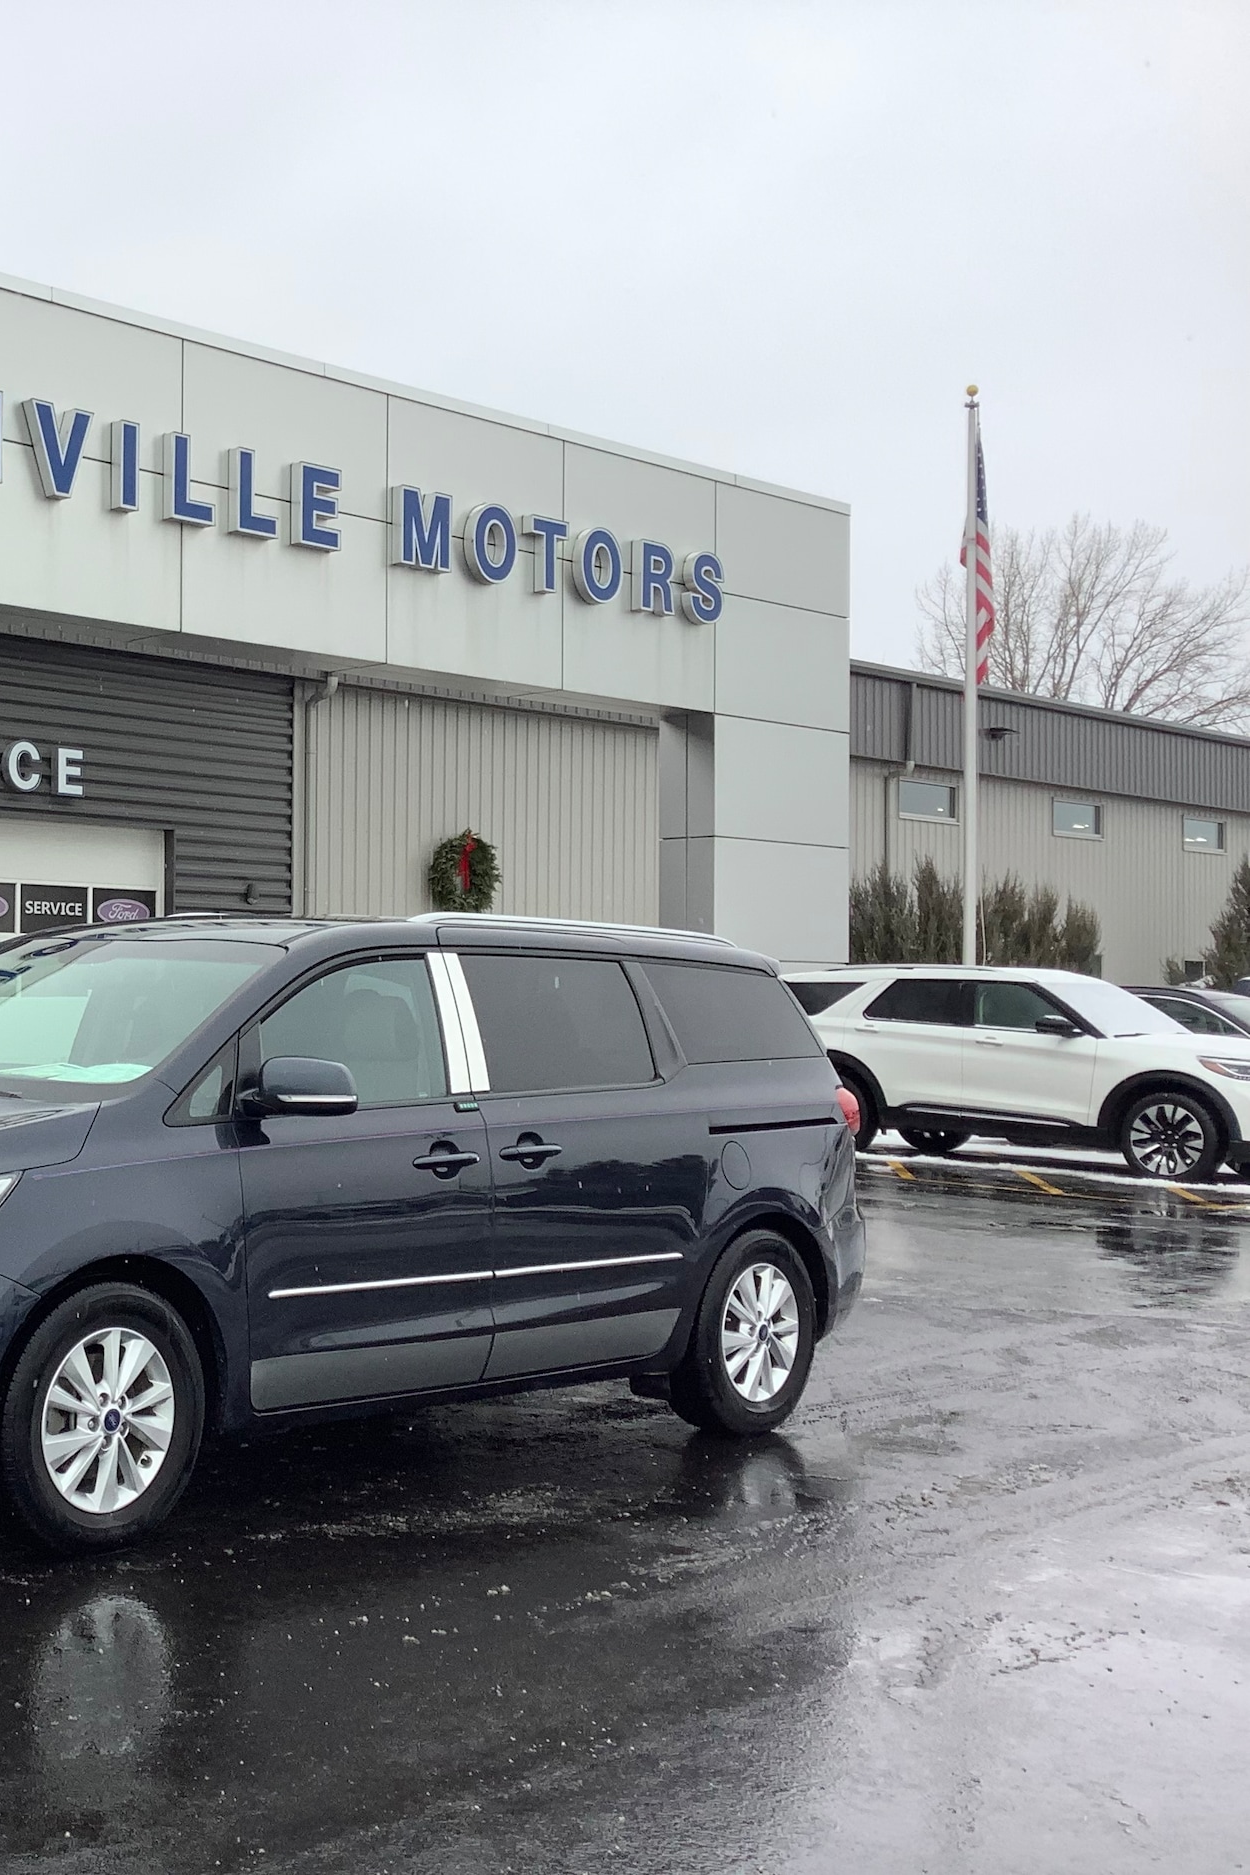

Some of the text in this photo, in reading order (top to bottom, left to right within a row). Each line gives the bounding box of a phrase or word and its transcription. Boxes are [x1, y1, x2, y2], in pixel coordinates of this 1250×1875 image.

[391, 485, 724, 625] MOTORS
[25, 900, 83, 916] SERVICE
[108, 902, 140, 921] Ford
